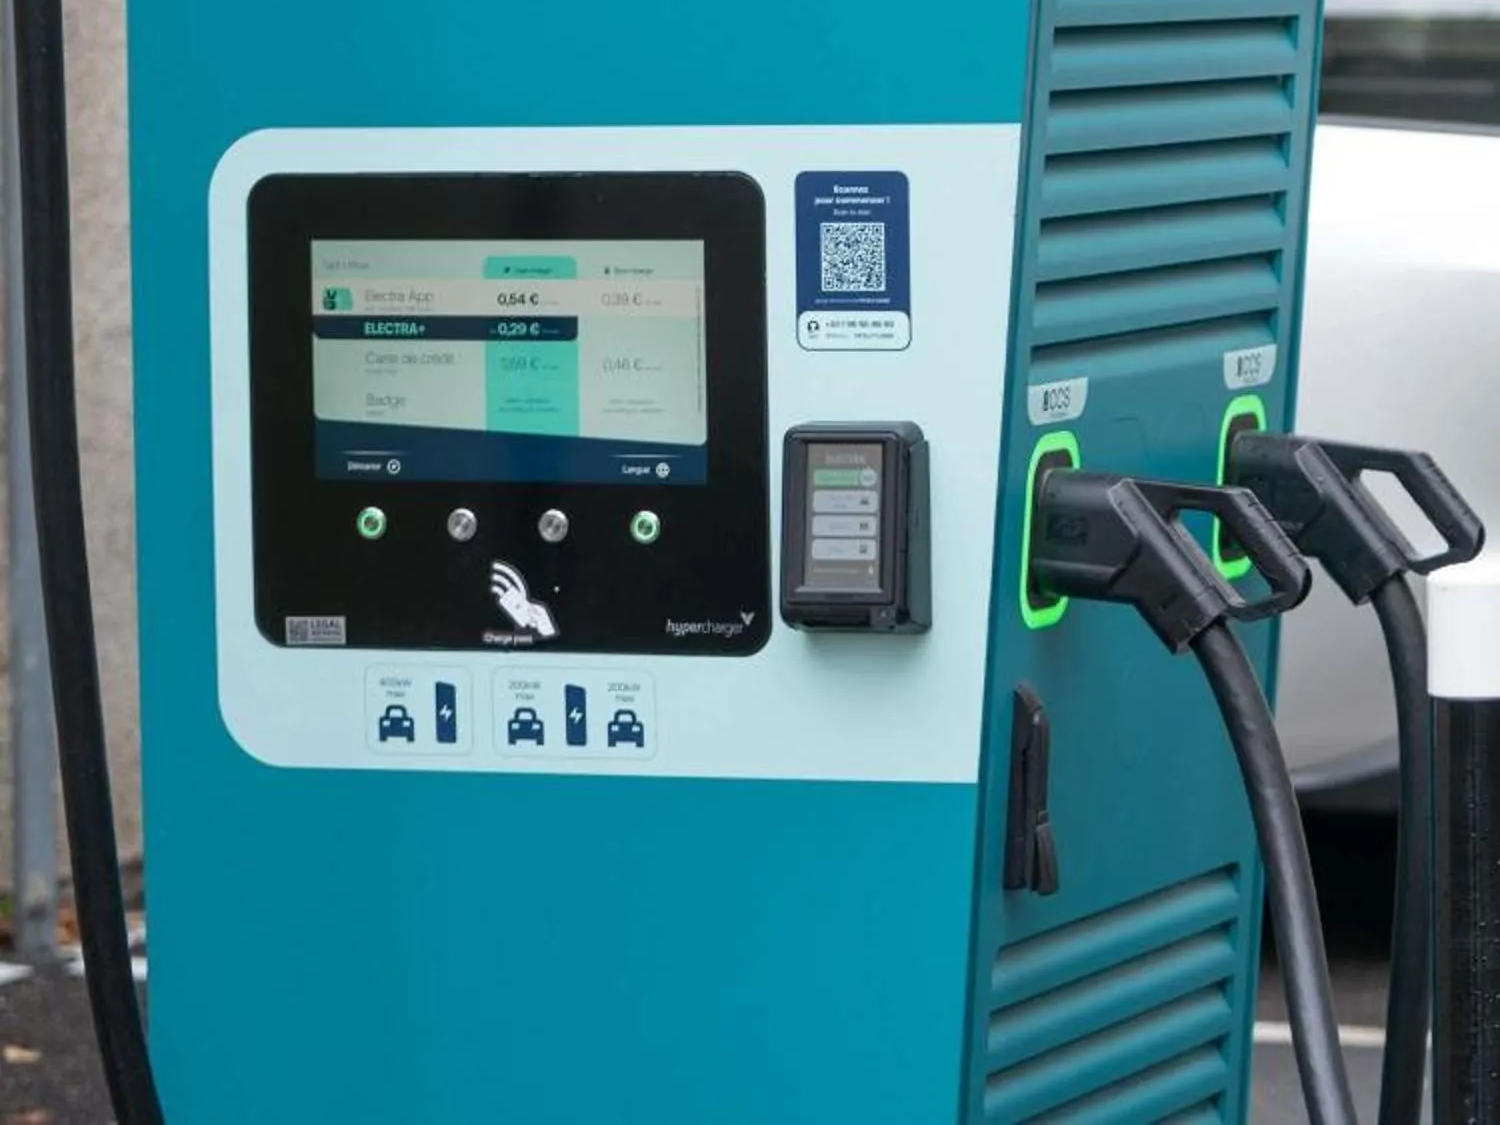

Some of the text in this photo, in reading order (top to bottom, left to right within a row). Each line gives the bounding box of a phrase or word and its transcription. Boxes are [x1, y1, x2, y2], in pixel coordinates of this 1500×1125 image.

[497, 292, 540, 307] 0,54 €
[497, 322, 527, 336] 0,29
